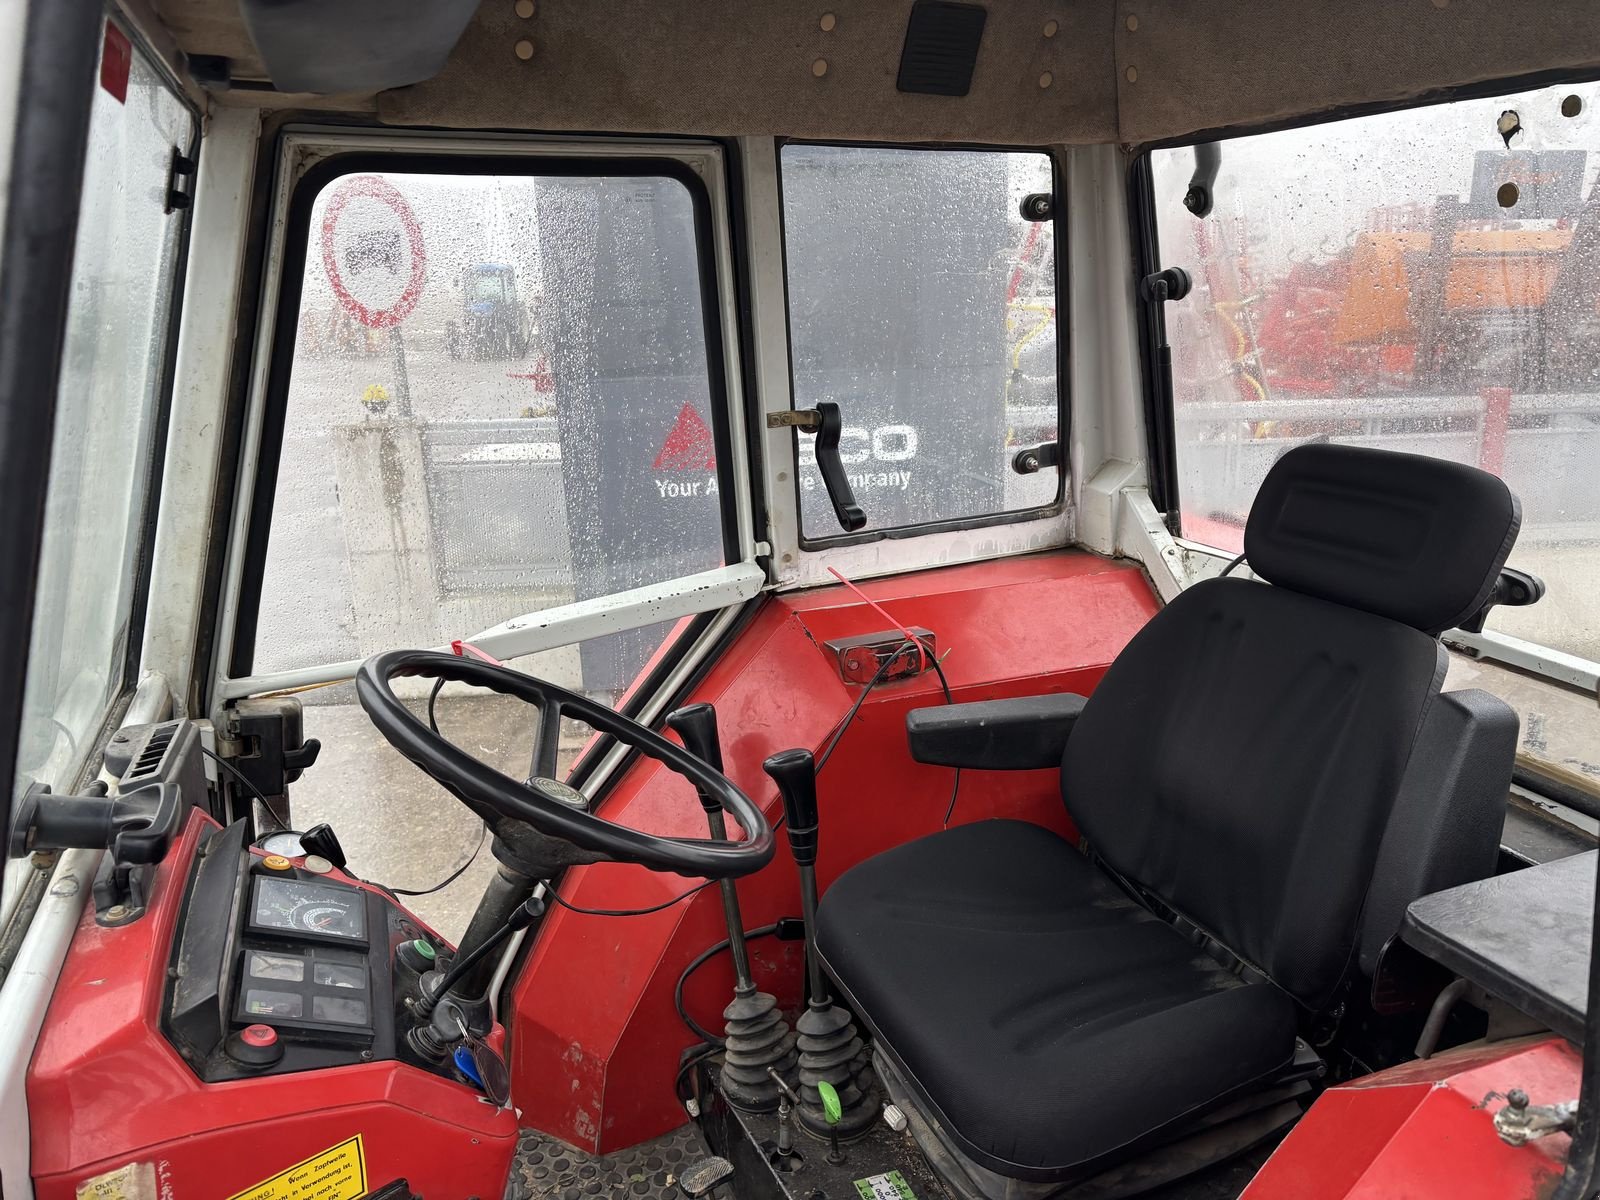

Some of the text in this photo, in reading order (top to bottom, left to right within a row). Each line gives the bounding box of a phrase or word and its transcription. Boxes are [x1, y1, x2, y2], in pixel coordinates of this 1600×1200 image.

[655, 479, 700, 498] Your
[288, 1171, 308, 1184] Wenn
[313, 1152, 346, 1172] Zapfwelle
[292, 1188, 298, 1196] in
[301, 1167, 341, 1191] Verwendung
[316, 1184, 332, 1196] nach
[335, 1175, 352, 1187] vorne
